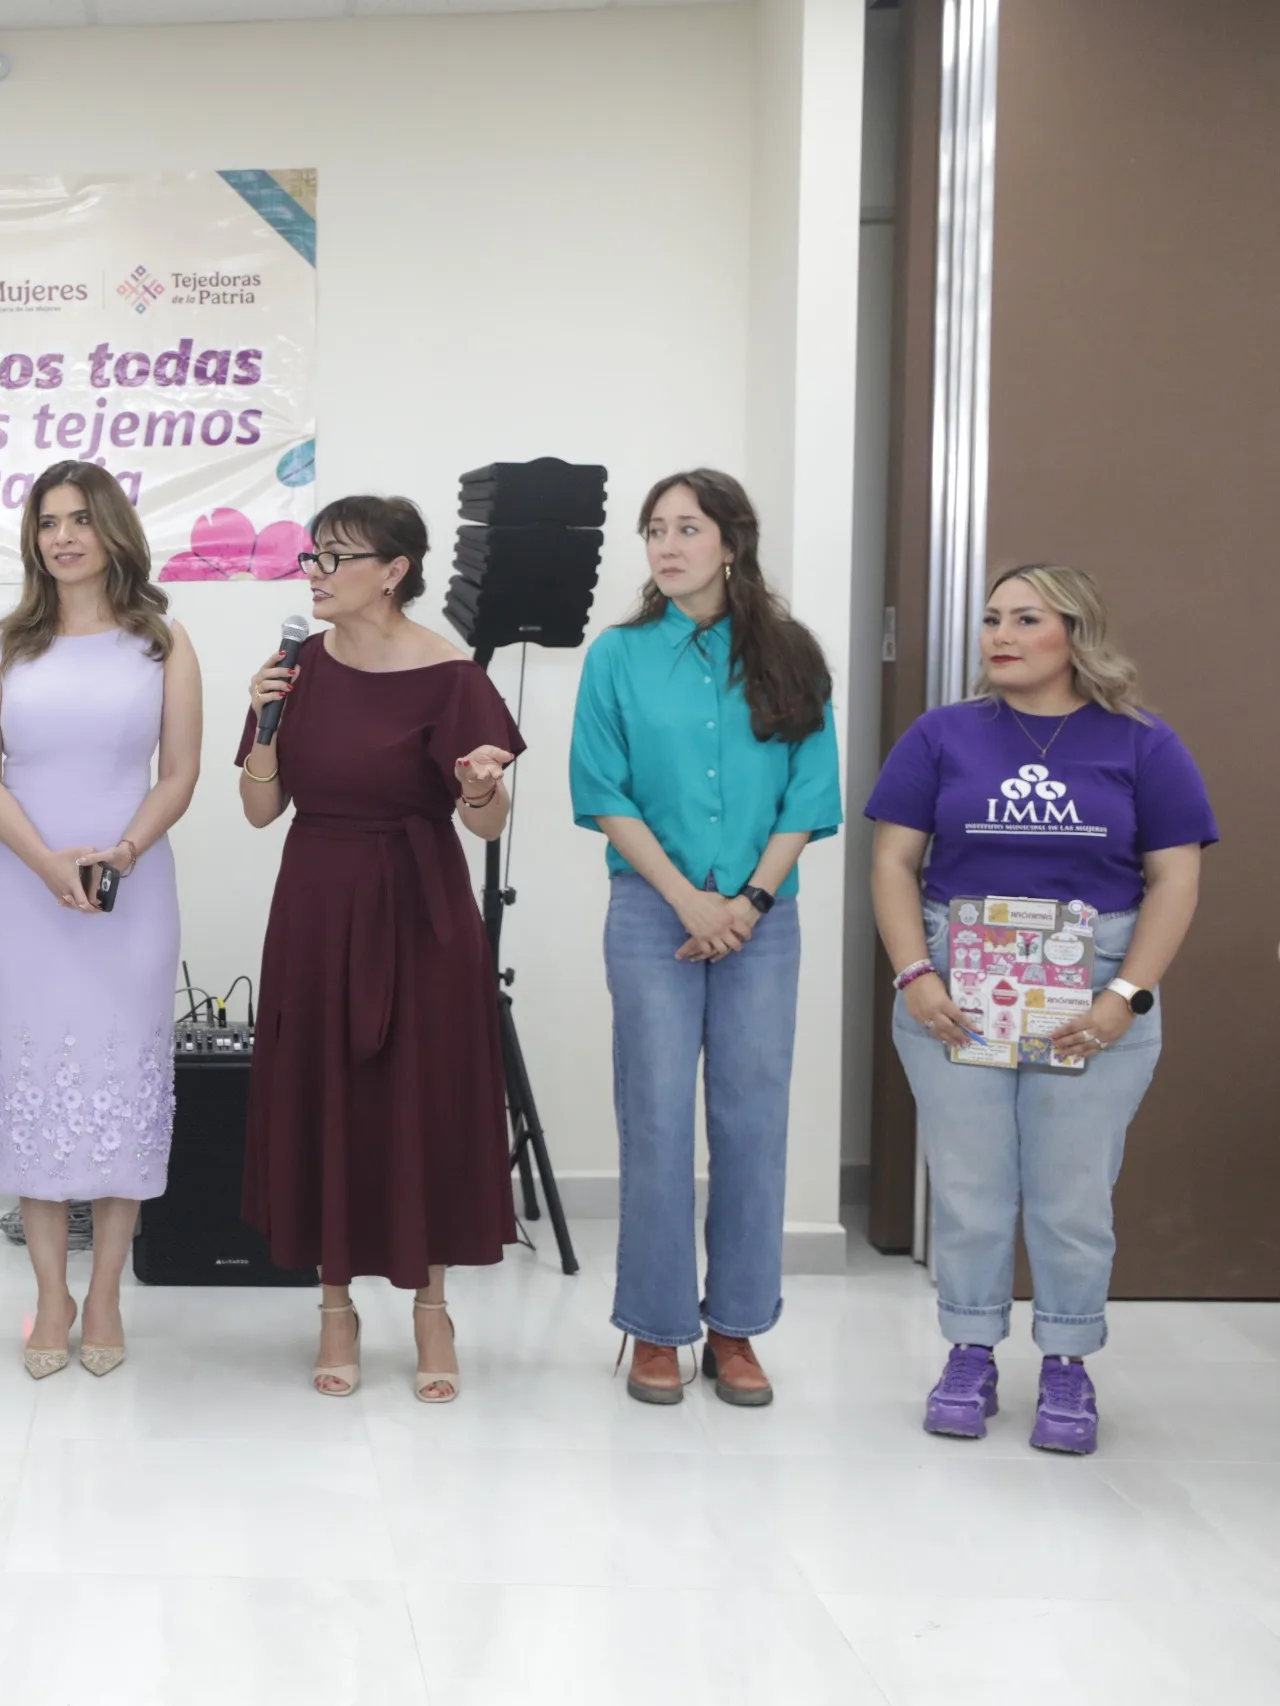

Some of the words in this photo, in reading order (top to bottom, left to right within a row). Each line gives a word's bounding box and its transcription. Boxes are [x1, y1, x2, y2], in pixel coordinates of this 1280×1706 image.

[171, 272, 261, 292] Tejedoras
[171, 294, 185, 304] de
[186, 294, 196, 304] la
[199, 289, 256, 305] Patria
[88, 338, 263, 388] todas
[32, 397, 263, 460] tejemos
[985, 798, 1084, 824] IMM
